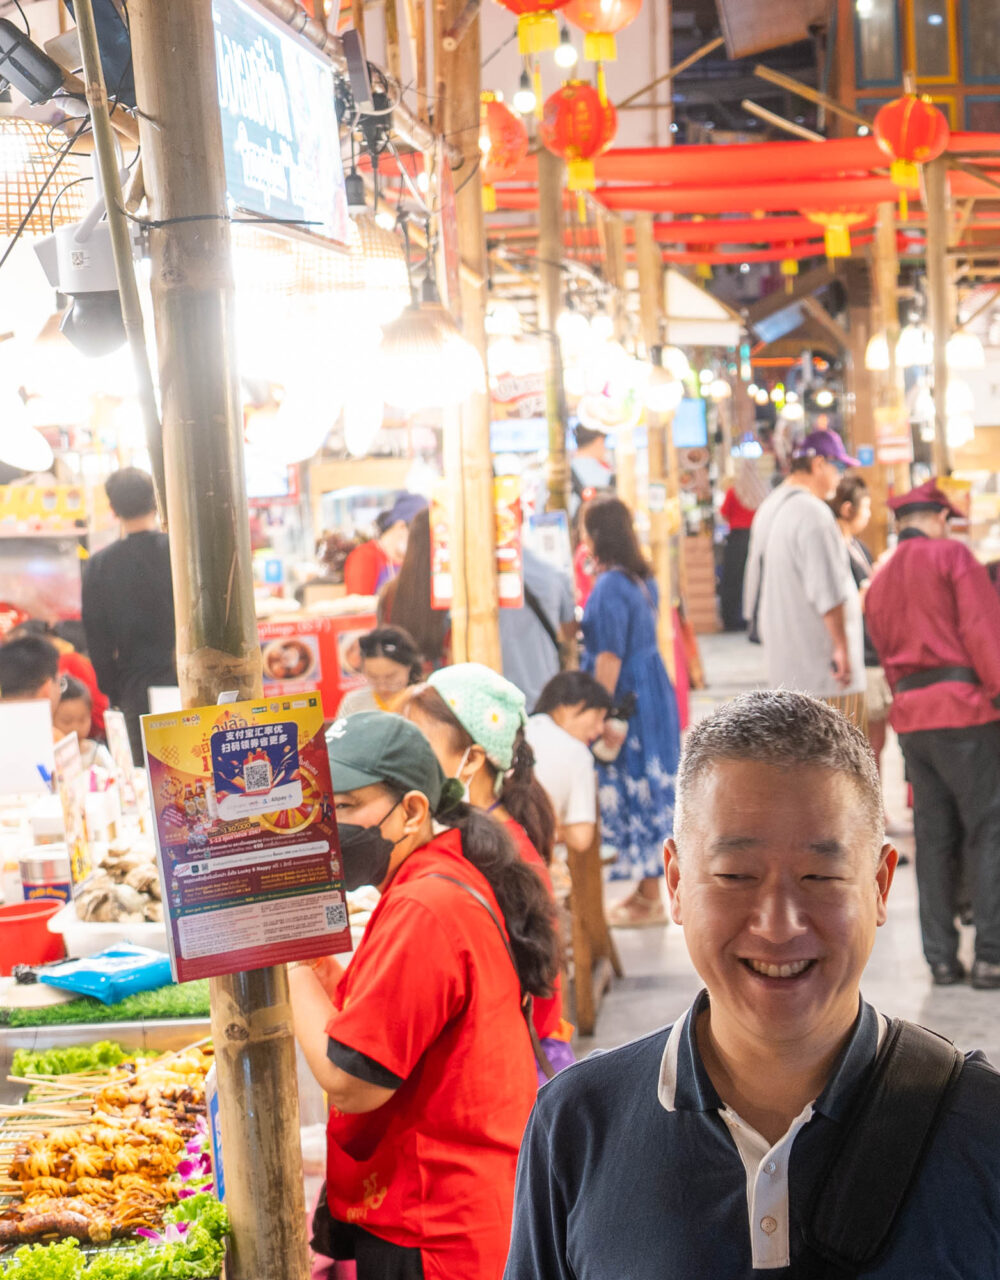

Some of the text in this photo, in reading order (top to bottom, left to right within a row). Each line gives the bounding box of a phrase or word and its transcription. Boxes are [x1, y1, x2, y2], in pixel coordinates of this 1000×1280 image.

[225, 724, 284, 742] 支付宝汇率优
[221, 733, 288, 754] 扫码领券省更多
